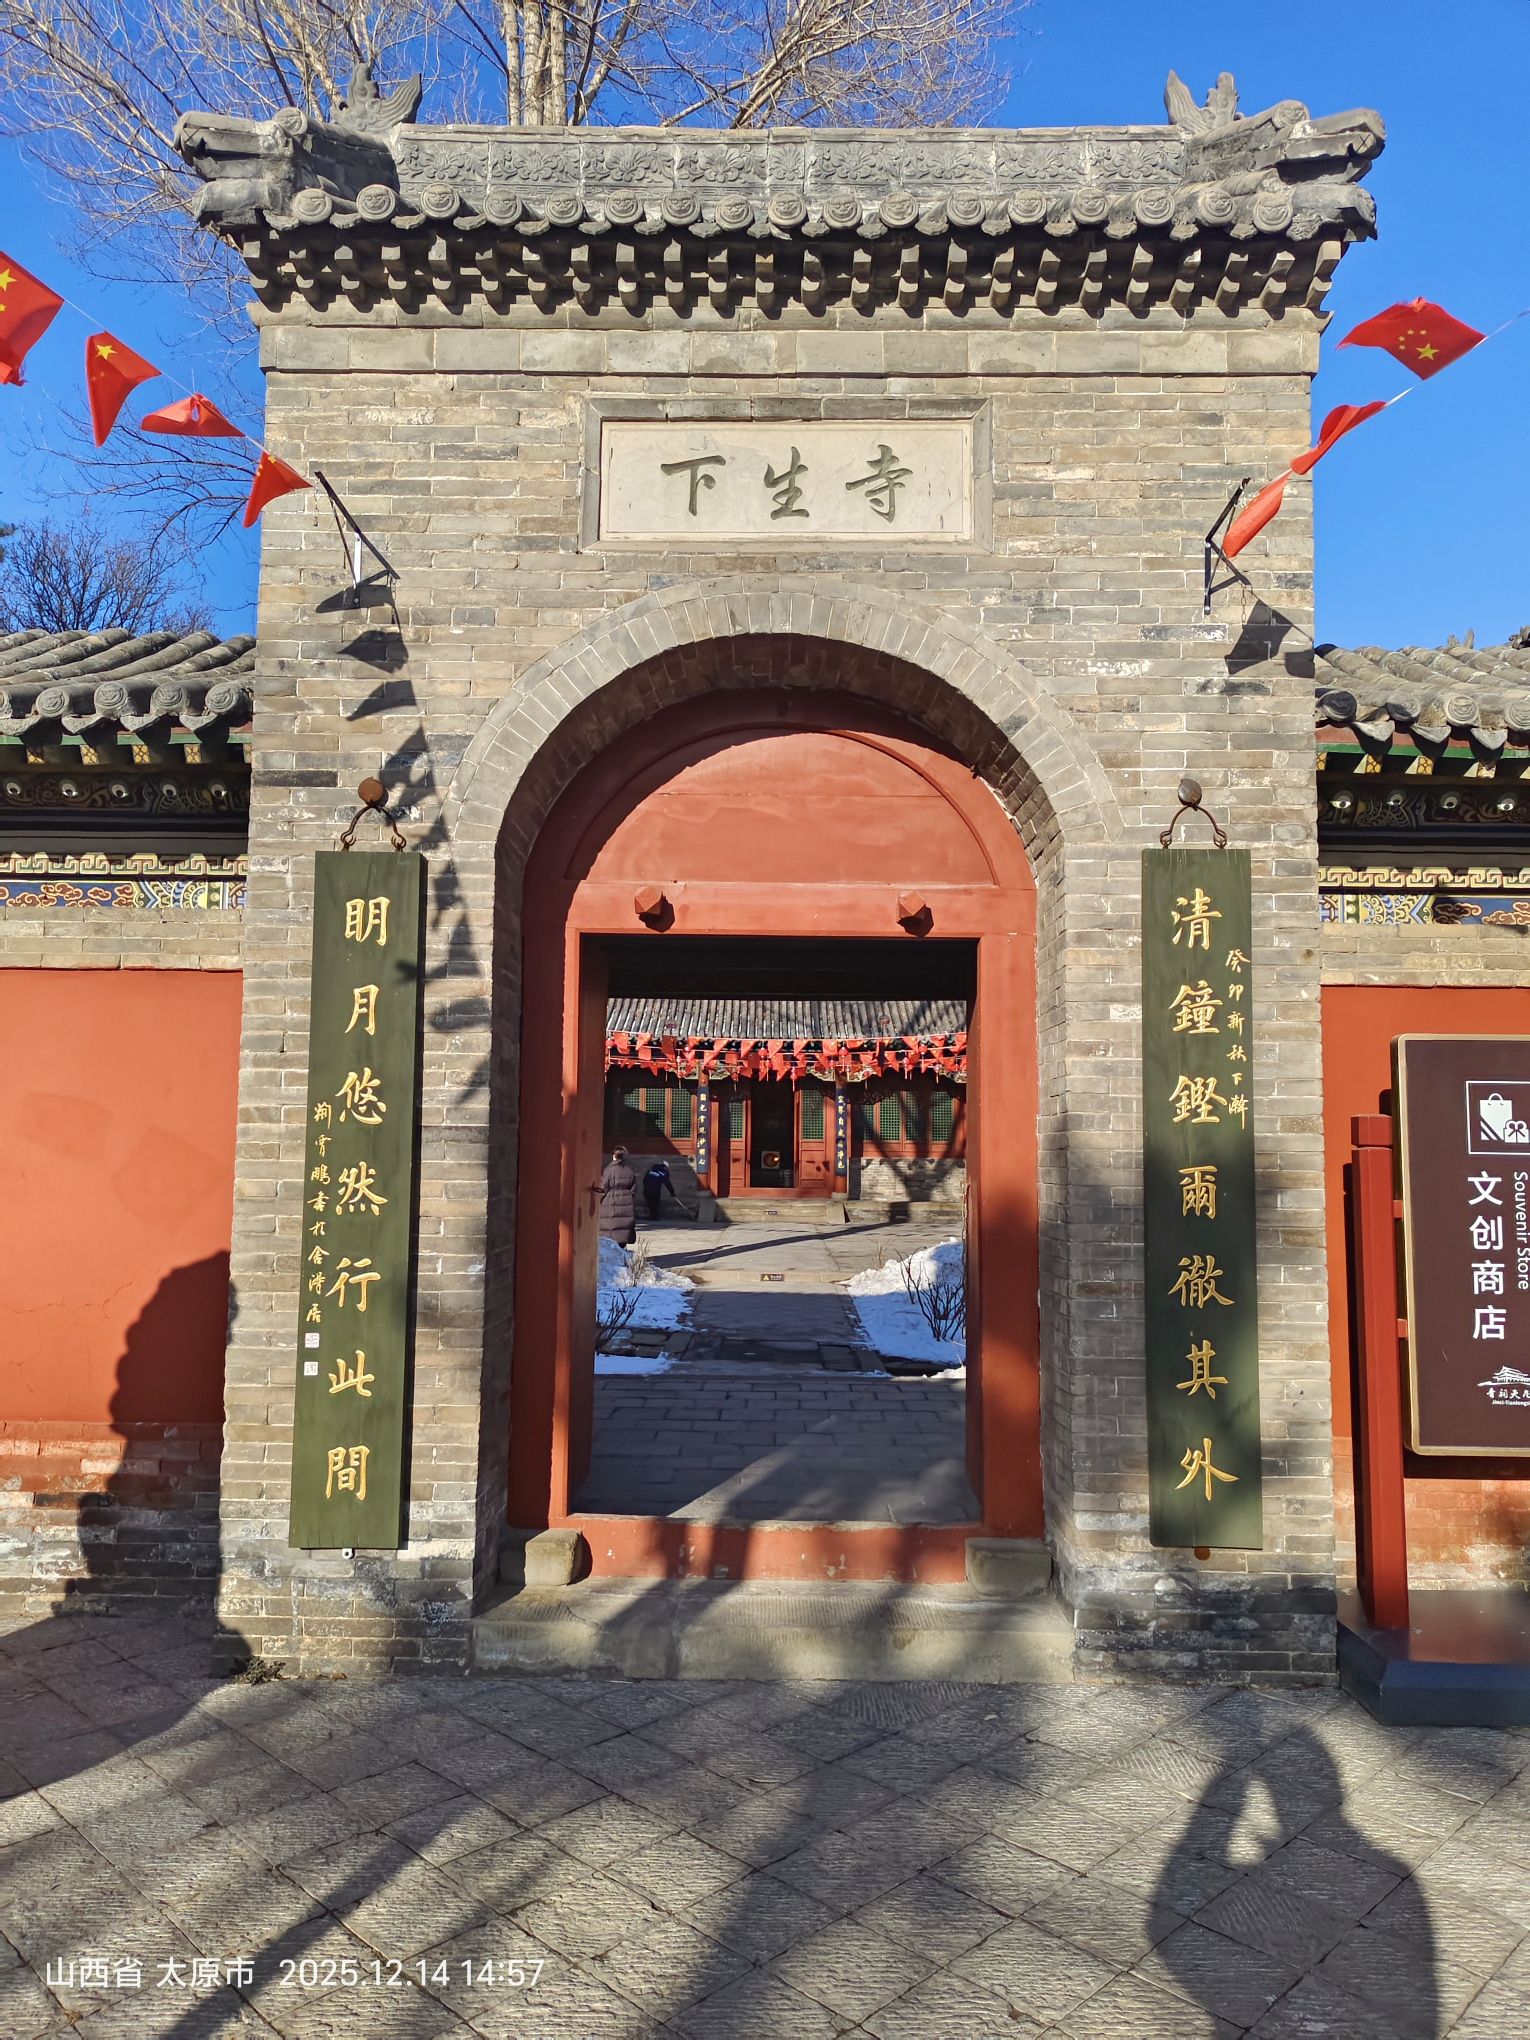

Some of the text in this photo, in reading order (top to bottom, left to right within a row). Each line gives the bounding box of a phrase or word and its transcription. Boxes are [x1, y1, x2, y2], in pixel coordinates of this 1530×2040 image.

[661, 444, 913, 523] 下生寺
[323, 895, 390, 1501] 明月悠然行此間
[1169, 887, 1239, 1502] 清鐘鏗爾徹其外
[1467, 1170, 1507, 1340] 文创商店
[1513, 1171, 1530, 1290] Souvenir Store
